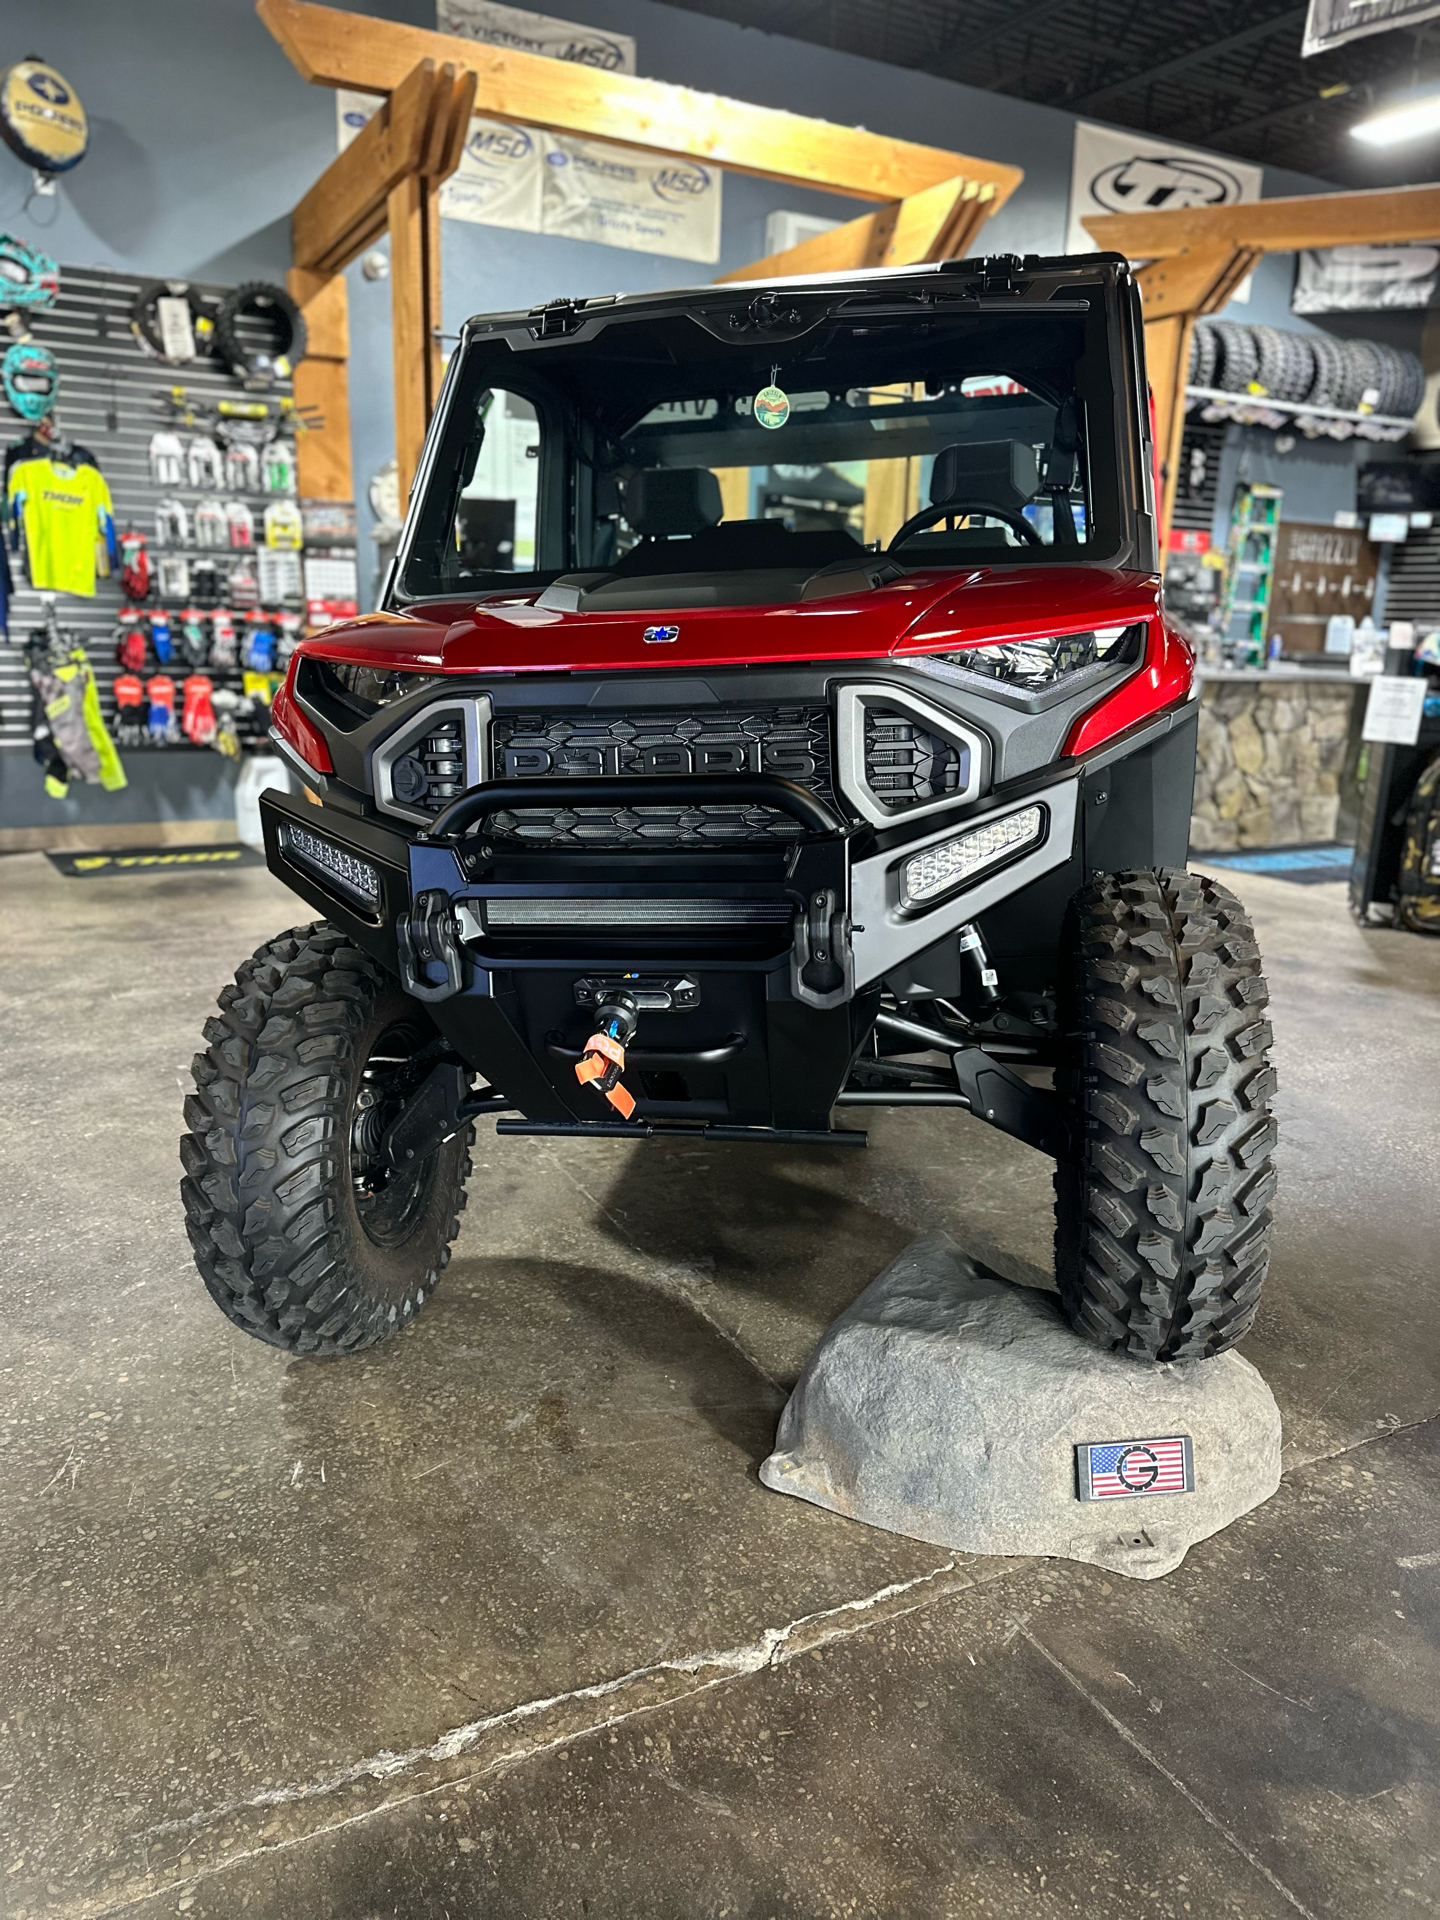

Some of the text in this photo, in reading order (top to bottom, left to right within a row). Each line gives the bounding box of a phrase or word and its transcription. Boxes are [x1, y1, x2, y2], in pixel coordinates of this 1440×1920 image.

[472, 25, 544, 50] VICTORY
[561, 43, 622, 71] MSD
[469, 131, 529, 158] MSD
[657, 168, 708, 195] MSD
[505, 741, 816, 778] POLARIS
